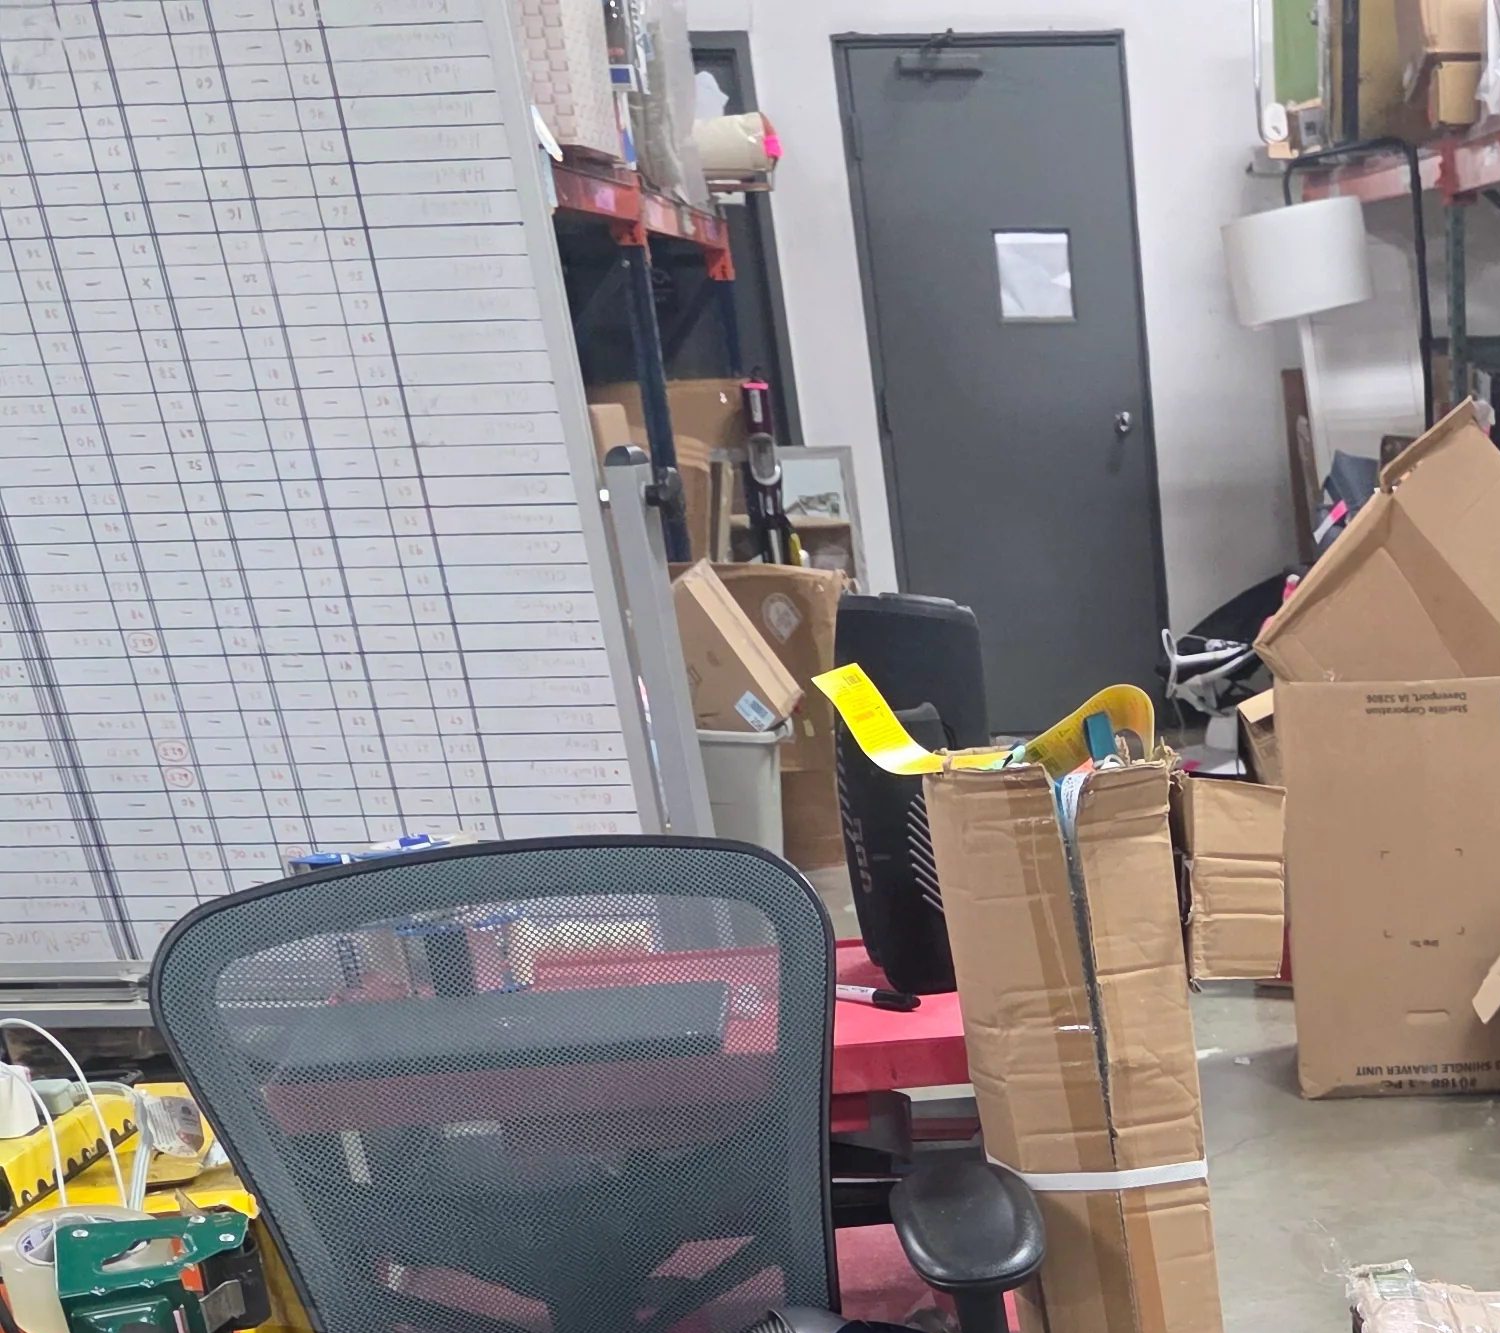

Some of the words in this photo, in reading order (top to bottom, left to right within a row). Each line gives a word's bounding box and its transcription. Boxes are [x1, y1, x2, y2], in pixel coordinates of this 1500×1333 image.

[227, 207, 242, 219] 16
[187, 460, 202, 470] 52
[1412, 692, 1467, 702] Davenport,
[1366, 705, 1426, 715] Corporation
[1428, 704, 1468, 713] Sterilite
[1355, 1066, 1383, 1076] UNIT
[1386, 1064, 1438, 1075] DRAWER
[1441, 1061, 1492, 1073] SHINGLE
